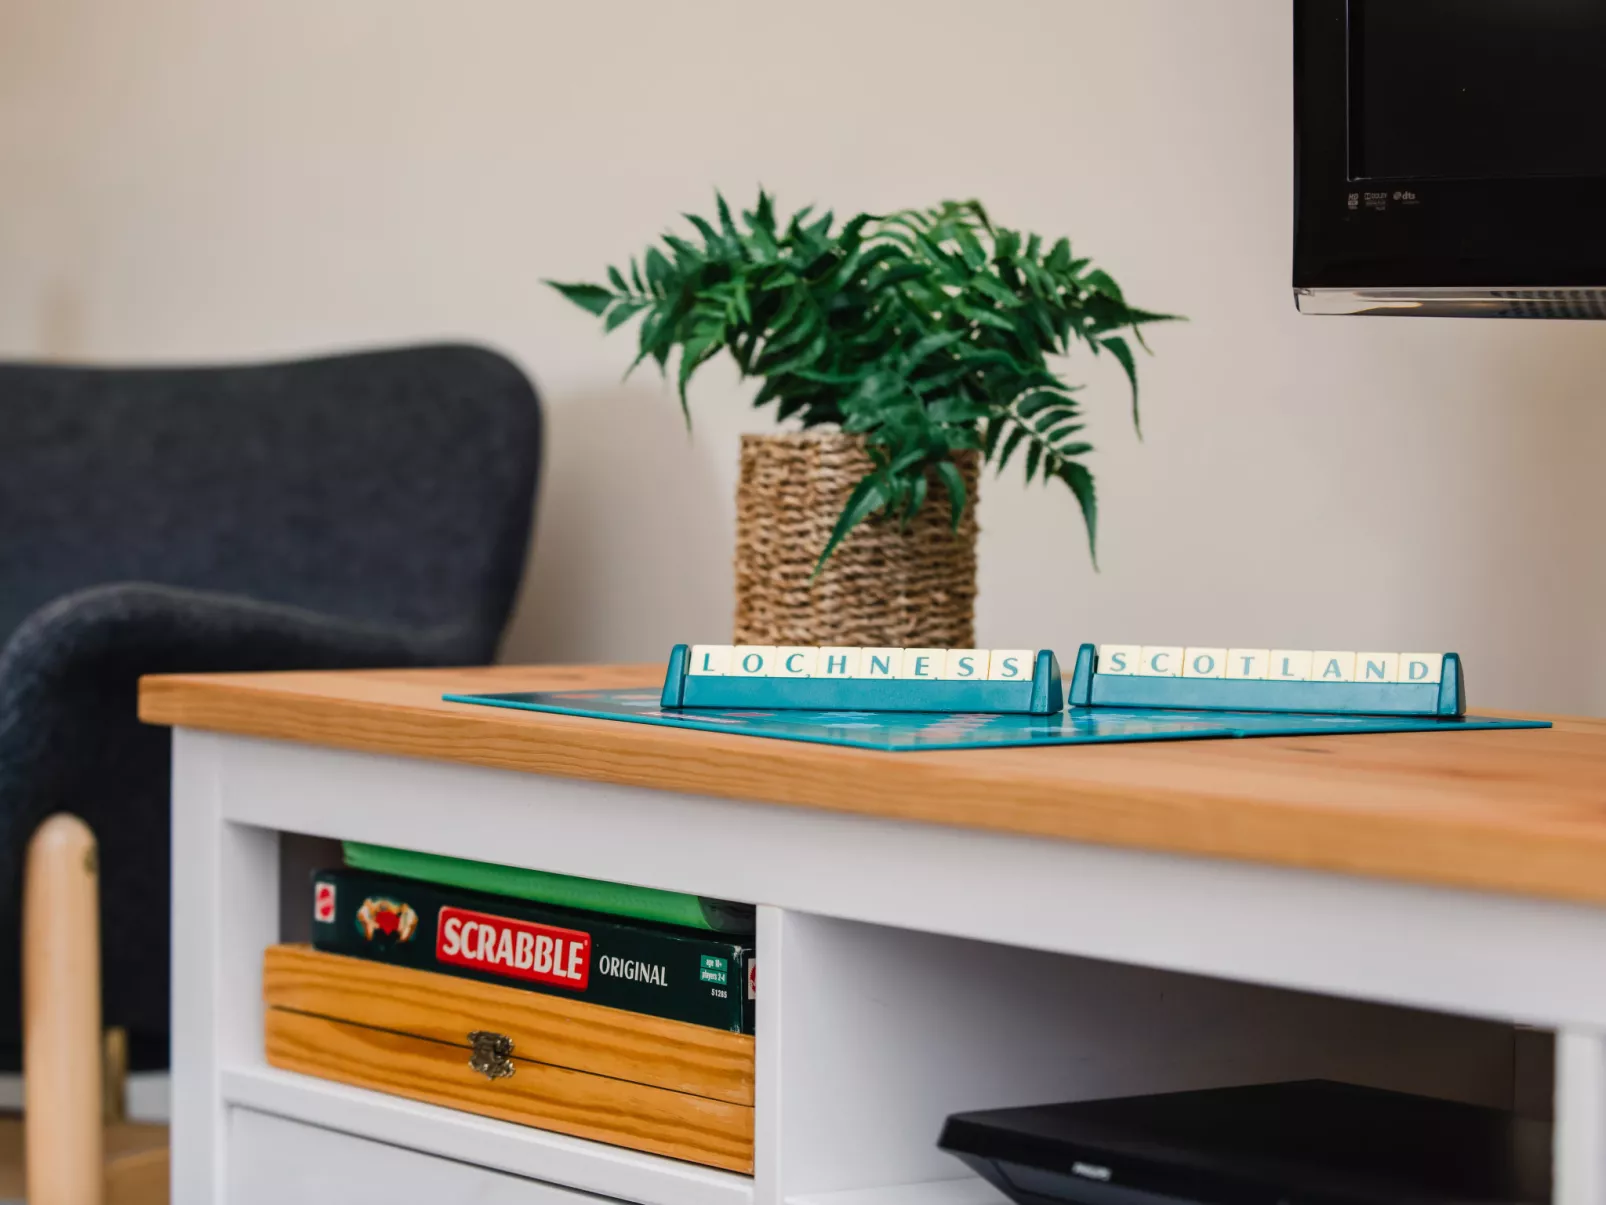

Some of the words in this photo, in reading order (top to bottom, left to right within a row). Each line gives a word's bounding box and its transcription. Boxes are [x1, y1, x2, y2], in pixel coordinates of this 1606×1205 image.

[1402, 191, 1416, 200] dts
[702, 652, 1020, 678] LOCHNESS
[1109, 652, 1430, 681] SCOTLAND
[442, 916, 584, 981] SCRABBLE
[599, 954, 668, 987] ORIGINAL
[701, 970, 717, 981] players
[717, 972, 726, 982] 2-4
